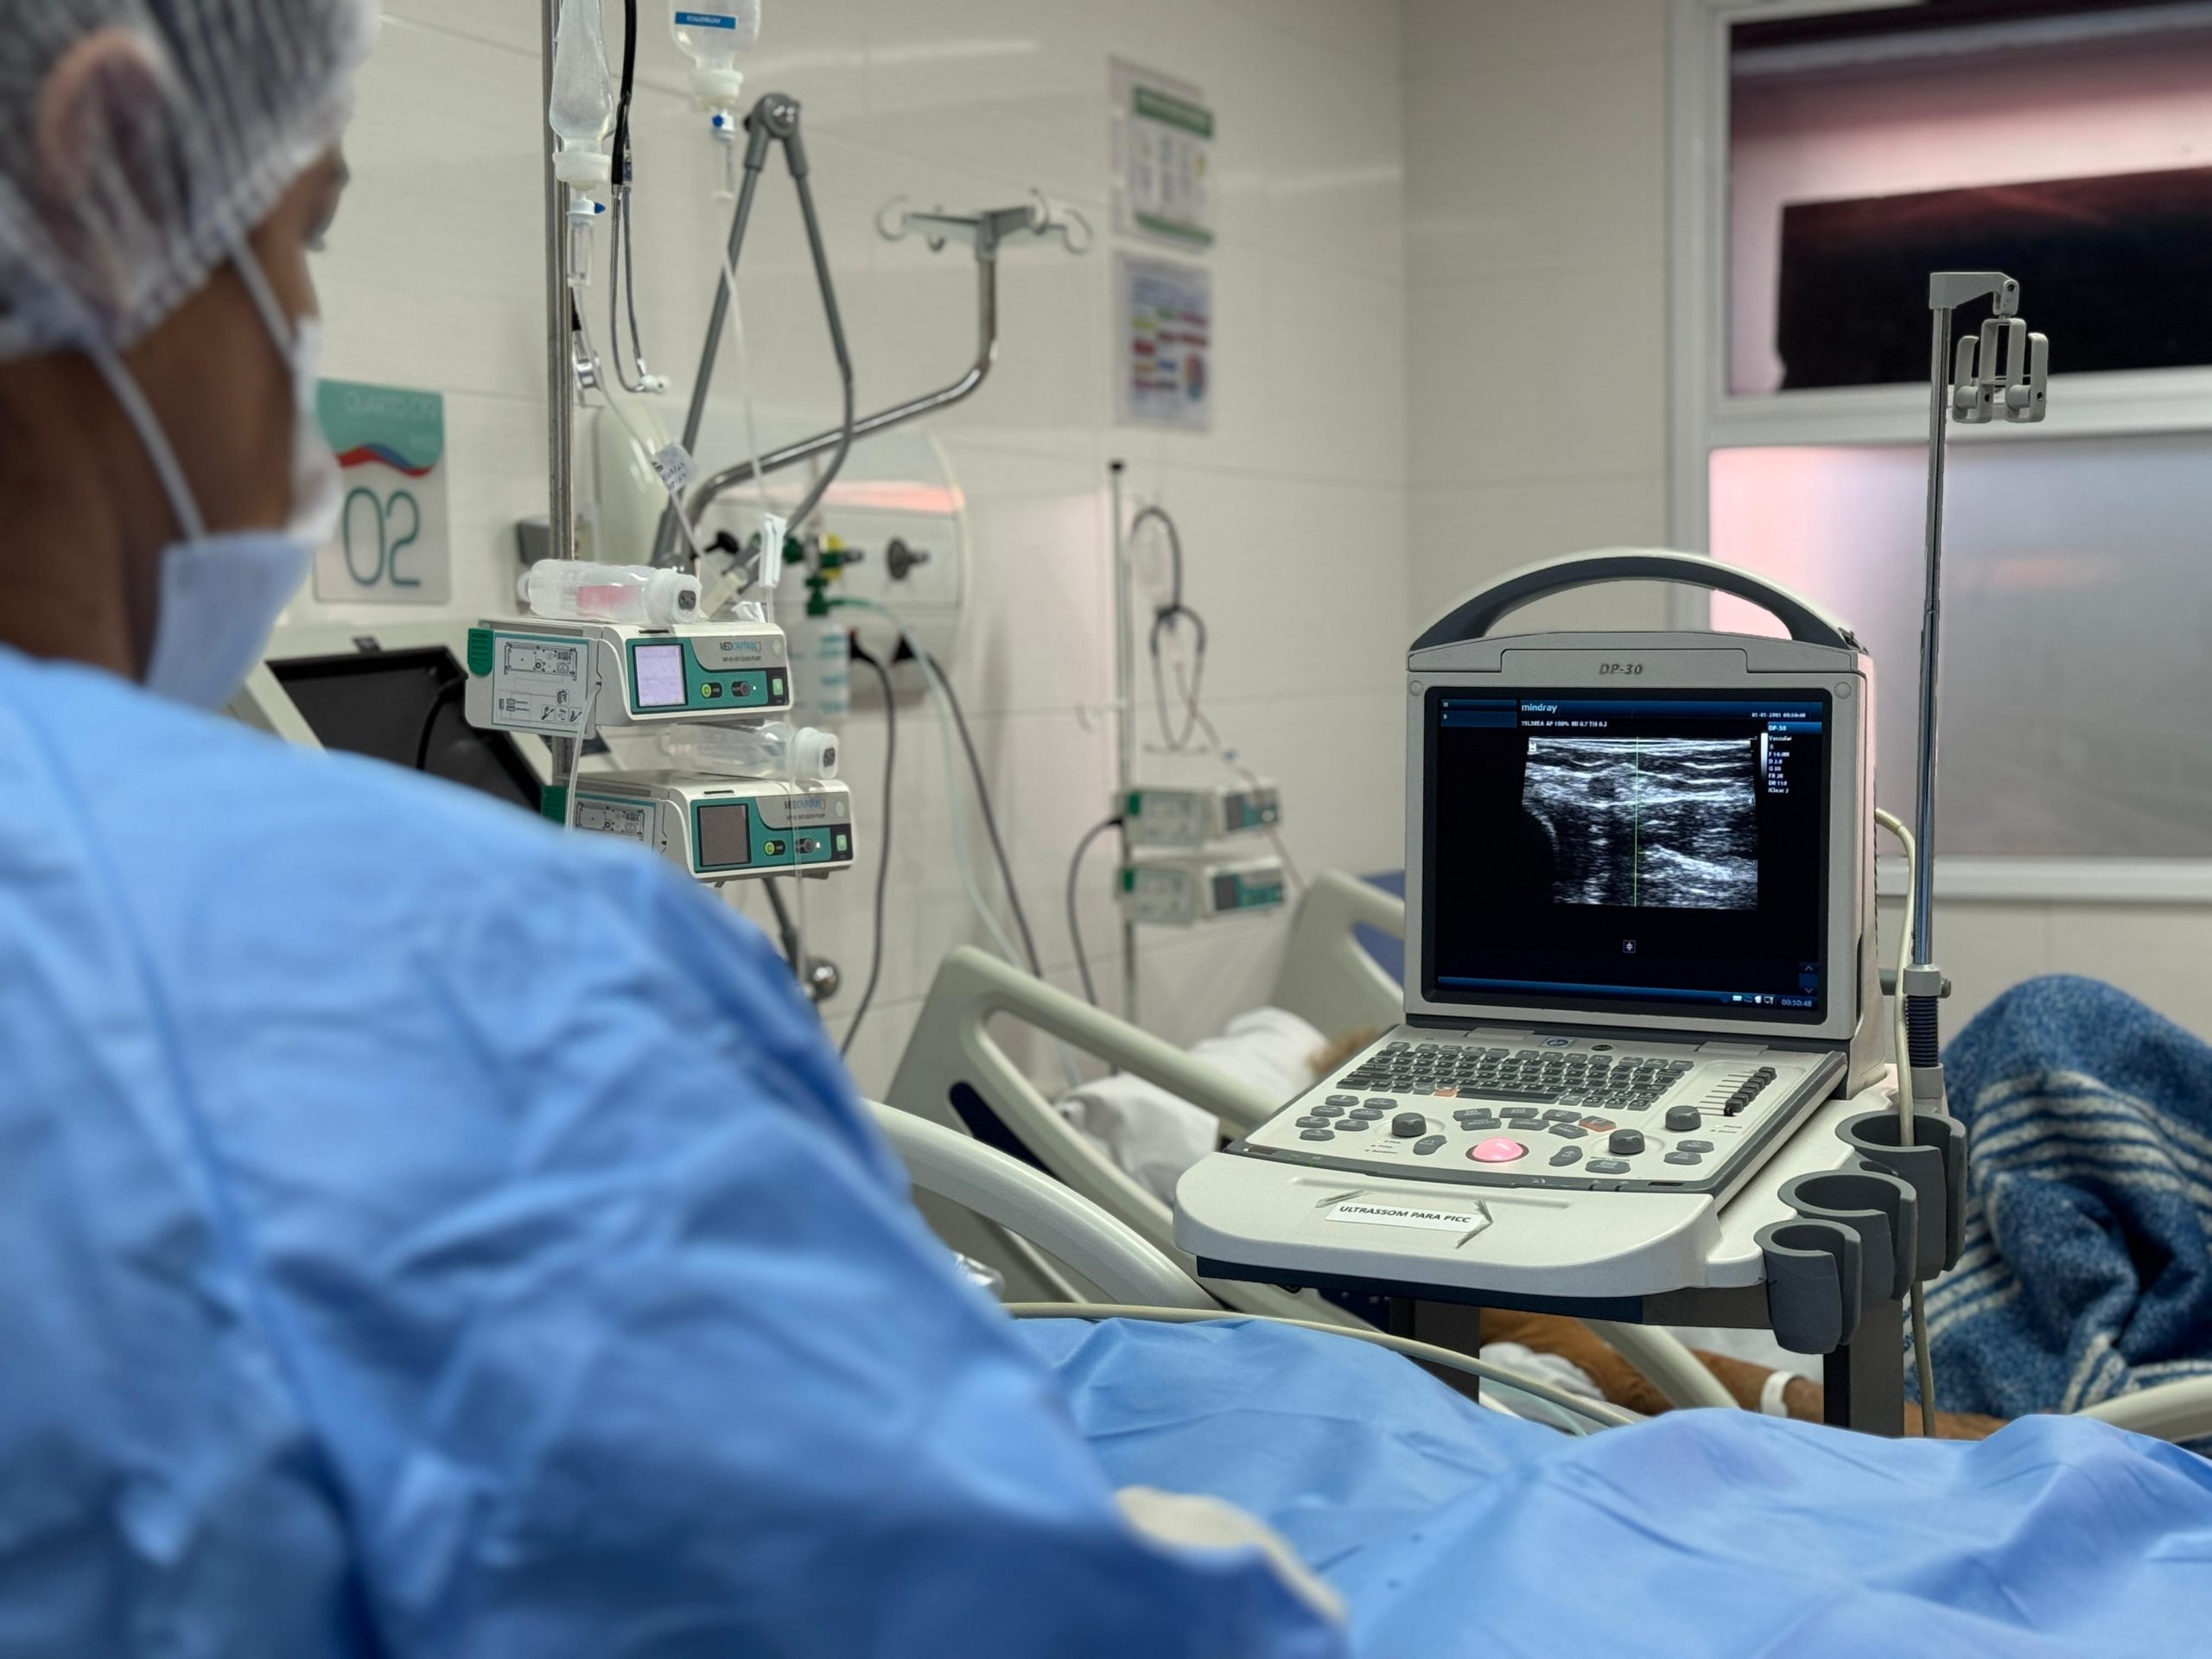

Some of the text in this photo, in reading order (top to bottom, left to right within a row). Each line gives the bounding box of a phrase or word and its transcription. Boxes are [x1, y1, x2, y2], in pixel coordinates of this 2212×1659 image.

[343, 485, 422, 588] 02
[1599, 664, 1643, 676] DP-30
[1521, 703, 1558, 714] mindray
[1339, 1205, 1471, 1224] ULTRASSOM PARA PICC
